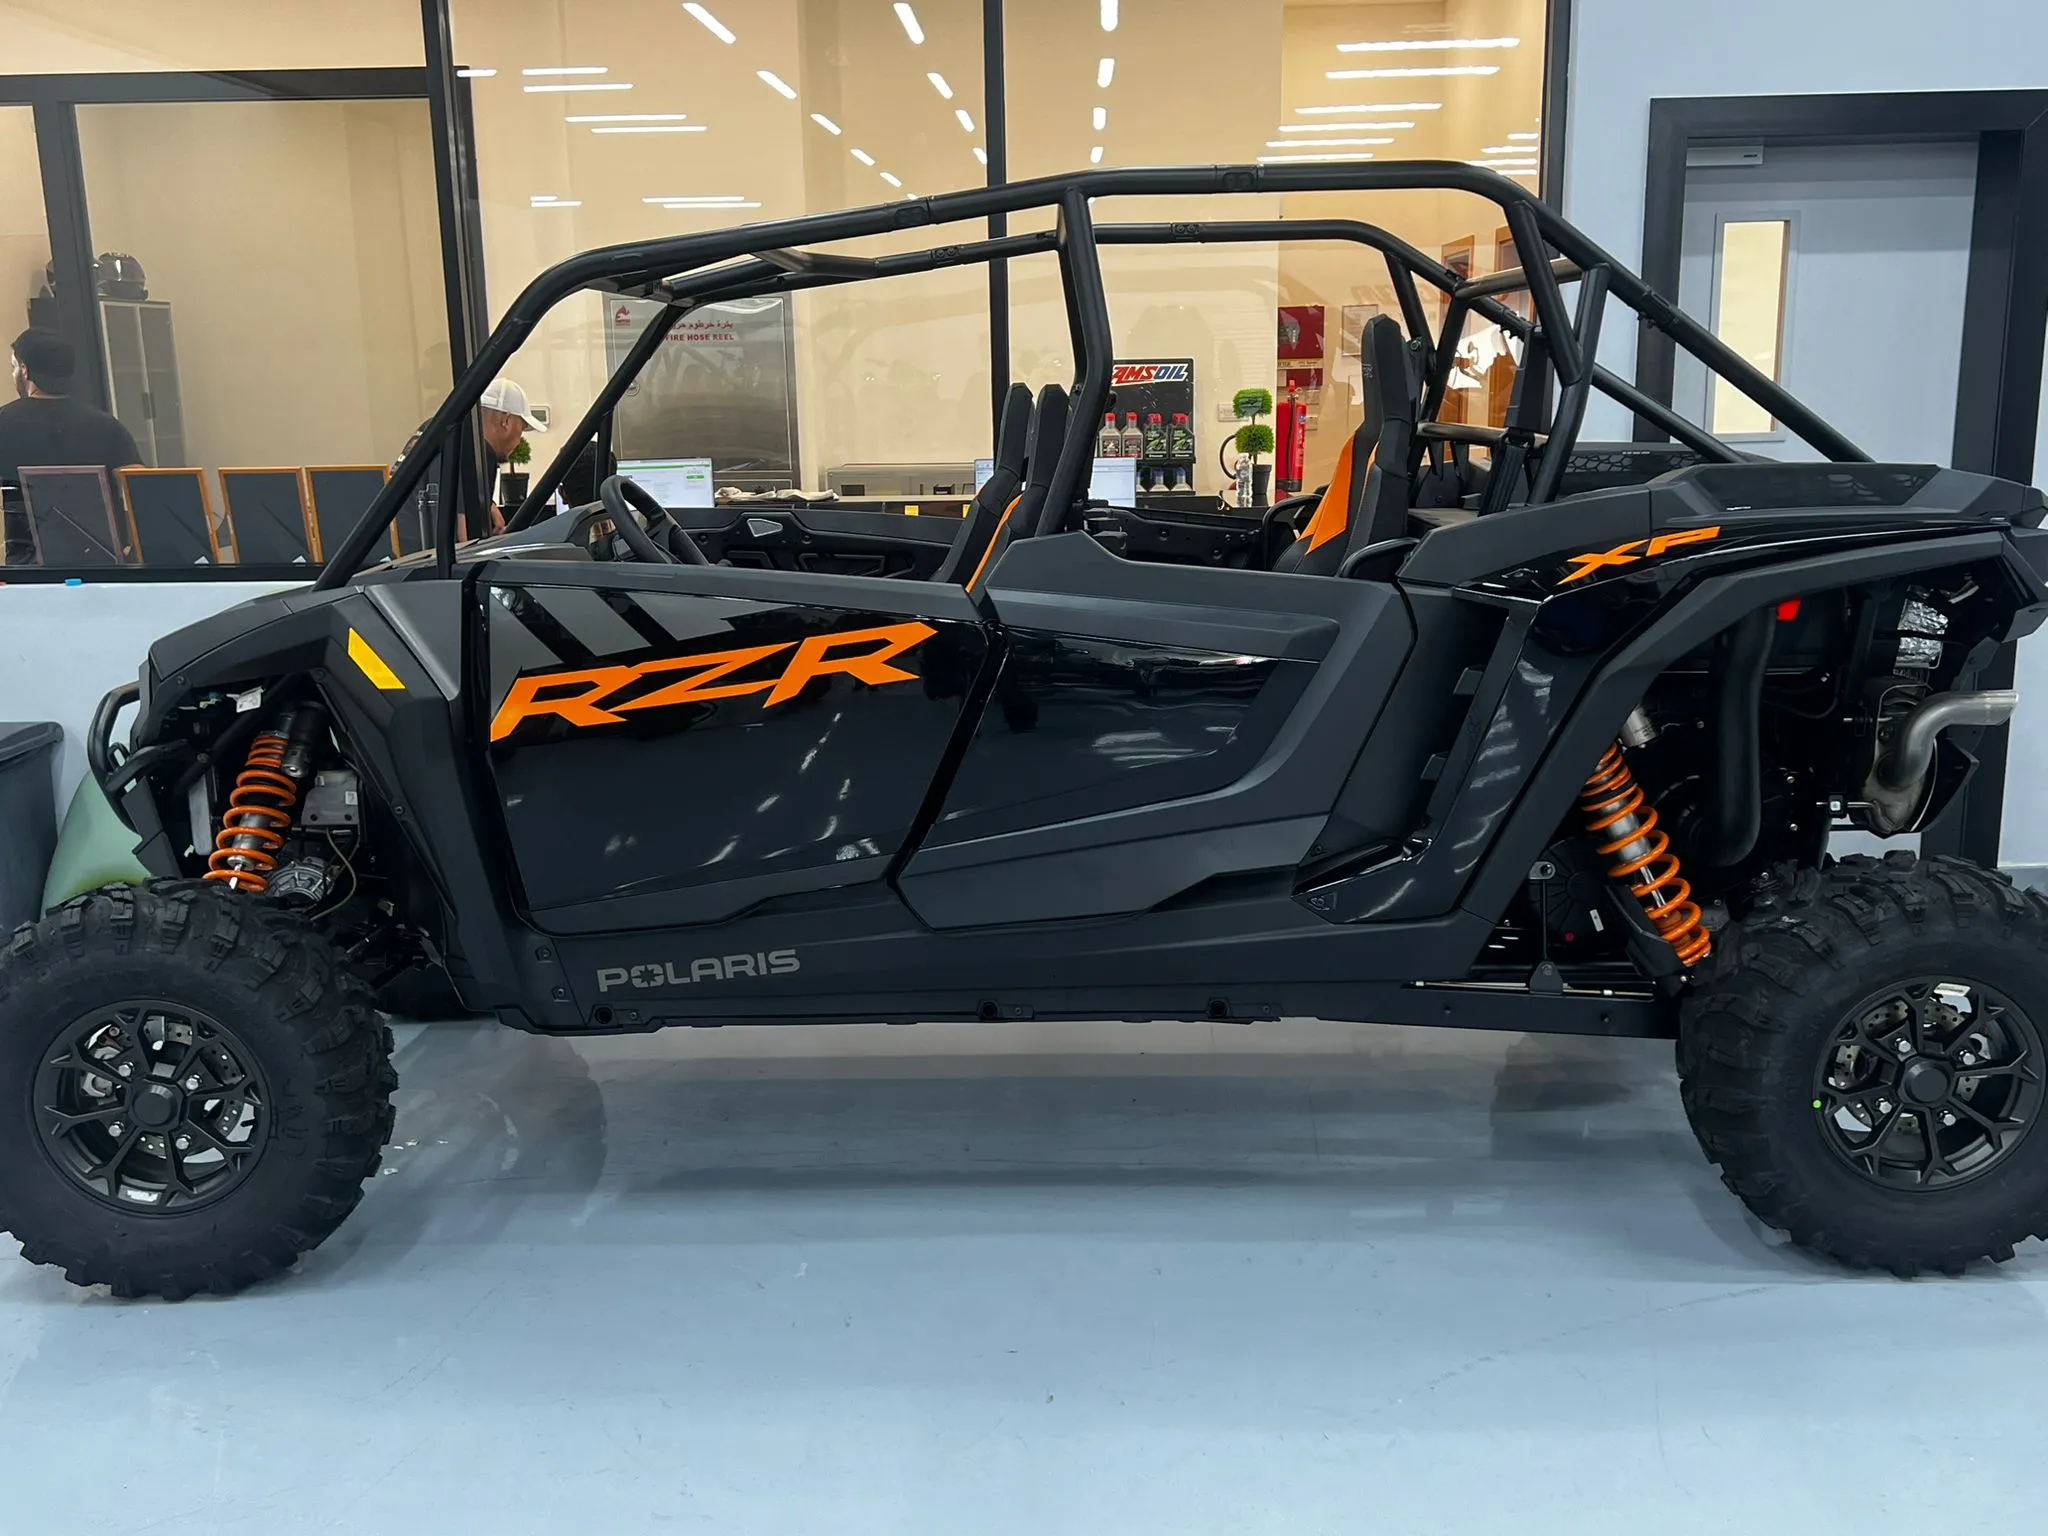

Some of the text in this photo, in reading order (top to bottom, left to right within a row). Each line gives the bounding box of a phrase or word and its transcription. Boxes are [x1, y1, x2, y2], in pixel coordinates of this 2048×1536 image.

[712, 333, 734, 341] REEL
[1112, 365, 1188, 386] AMSOIL
[1555, 526, 1721, 586] XP
[490, 621, 938, 743] RZR
[596, 948, 801, 993] POLARIS
